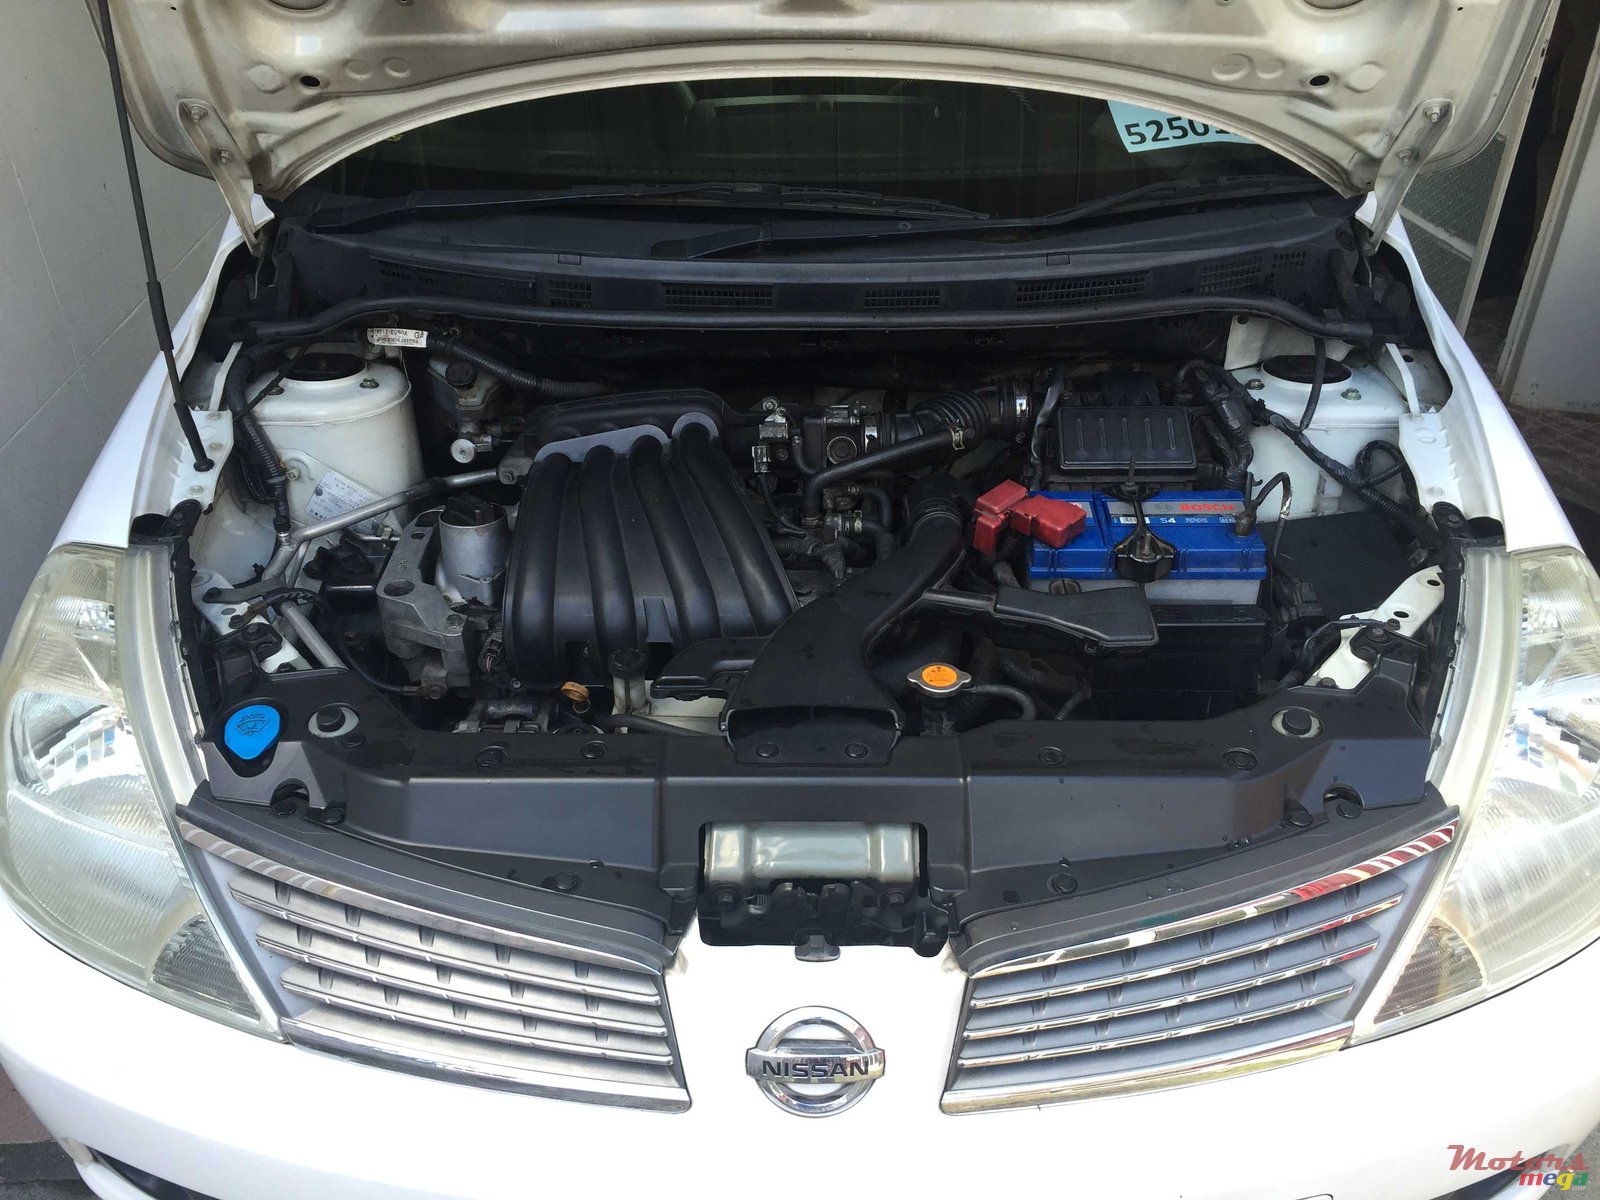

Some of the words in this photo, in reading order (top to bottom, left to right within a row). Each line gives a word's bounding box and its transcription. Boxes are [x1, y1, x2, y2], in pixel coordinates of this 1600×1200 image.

[1124, 116, 1230, 145] 5250
[1179, 503, 1235, 512] BOSCH
[762, 1060, 869, 1078] NISSAN
